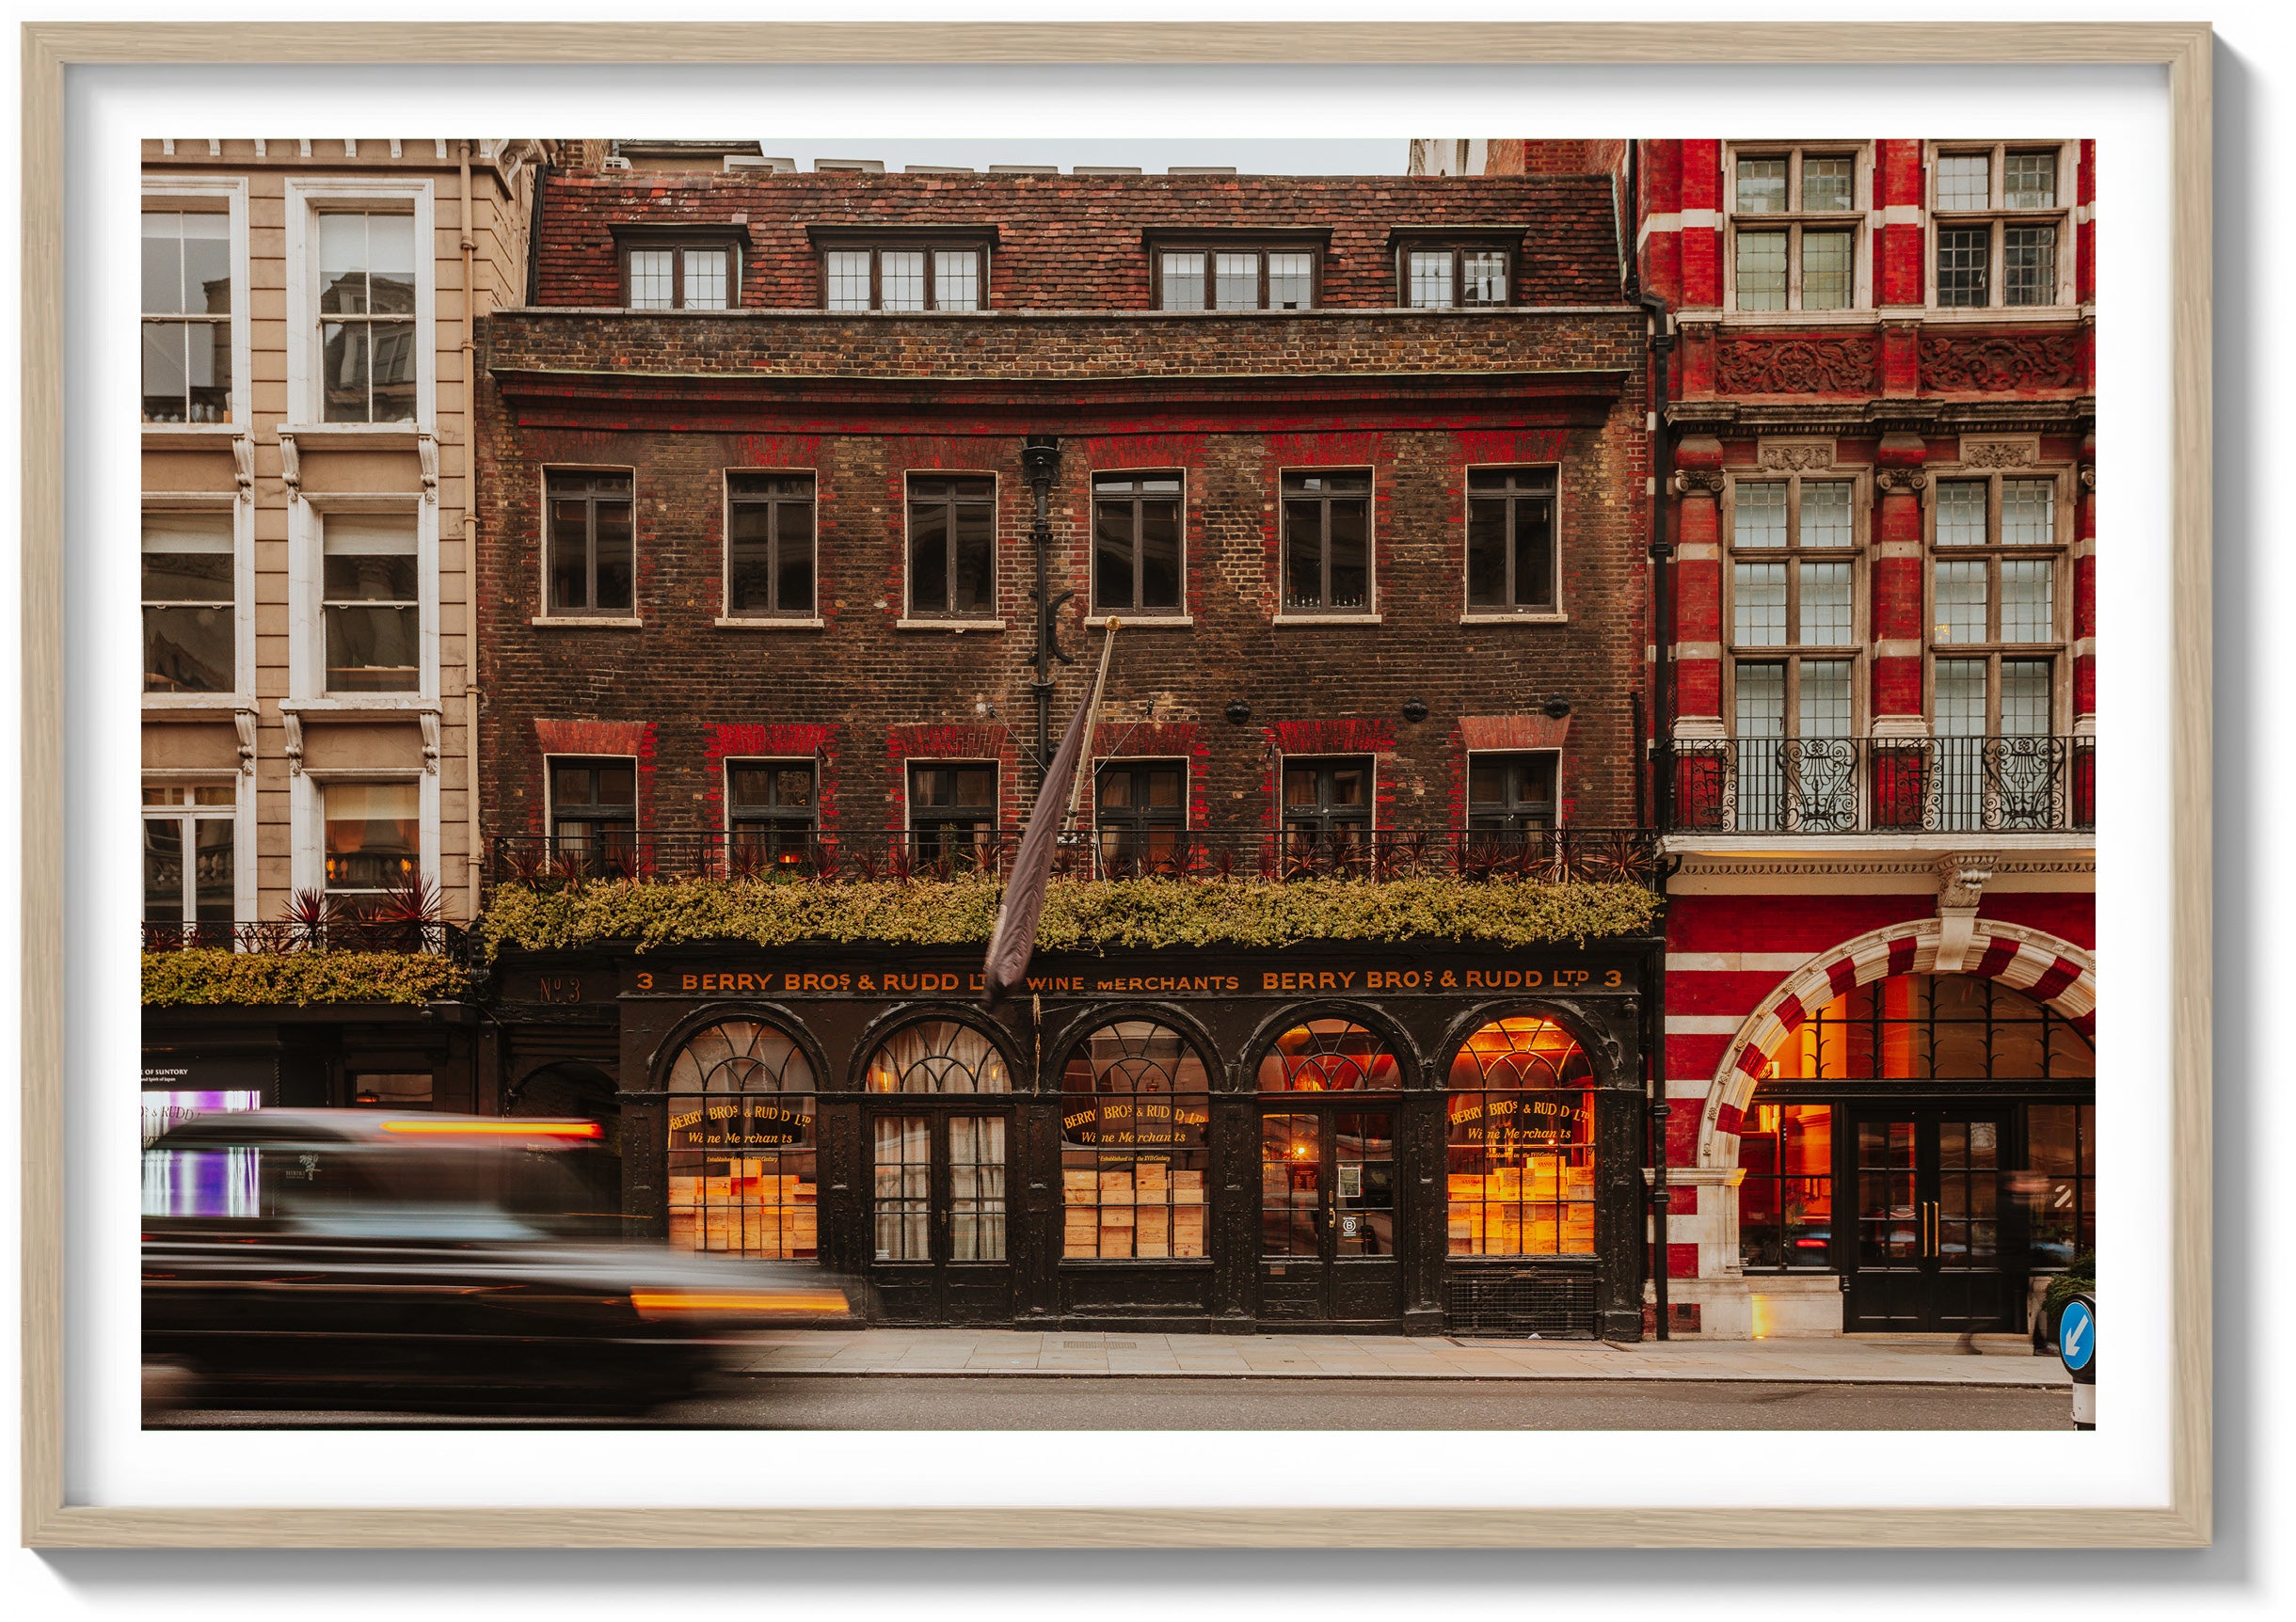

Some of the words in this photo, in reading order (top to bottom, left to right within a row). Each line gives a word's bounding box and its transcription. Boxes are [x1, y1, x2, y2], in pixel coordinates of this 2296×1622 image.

[569, 978, 581, 1003] 3
[636, 972, 653, 990] 3
[682, 973, 773, 991] BERRY
[857, 974, 876, 991] &
[884, 973, 960, 991] RUDD
[1026, 976, 1085, 991] WINE
[1097, 976, 1240, 991] MERCHANTS
[1263, 971, 1356, 990] BERRY
[1440, 970, 1459, 988] &
[1466, 970, 1543, 988] RUDD
[1554, 970, 1590, 987] LTD
[1604, 969, 1622, 988] 3
[162, 1105, 194, 1121] RUDD
[670, 1109, 702, 1130] BERRY
[743, 1107, 752, 1118] &
[794, 1114, 811, 1127] LTD
[1063, 1109, 1096, 1129] BERRY
[1137, 1106, 1142, 1117] &
[1450, 1105, 1483, 1126] BERRY
[1523, 1104, 1531, 1114] &
[689, 1132, 721, 1143] Wine
[725, 1132, 792, 1143] Merchants
[1082, 1132, 1115, 1143] Wine
[1118, 1131, 1186, 1143] Merchants
[1468, 1128, 1501, 1139] Wine
[1504, 1128, 1571, 1139] Merchants
